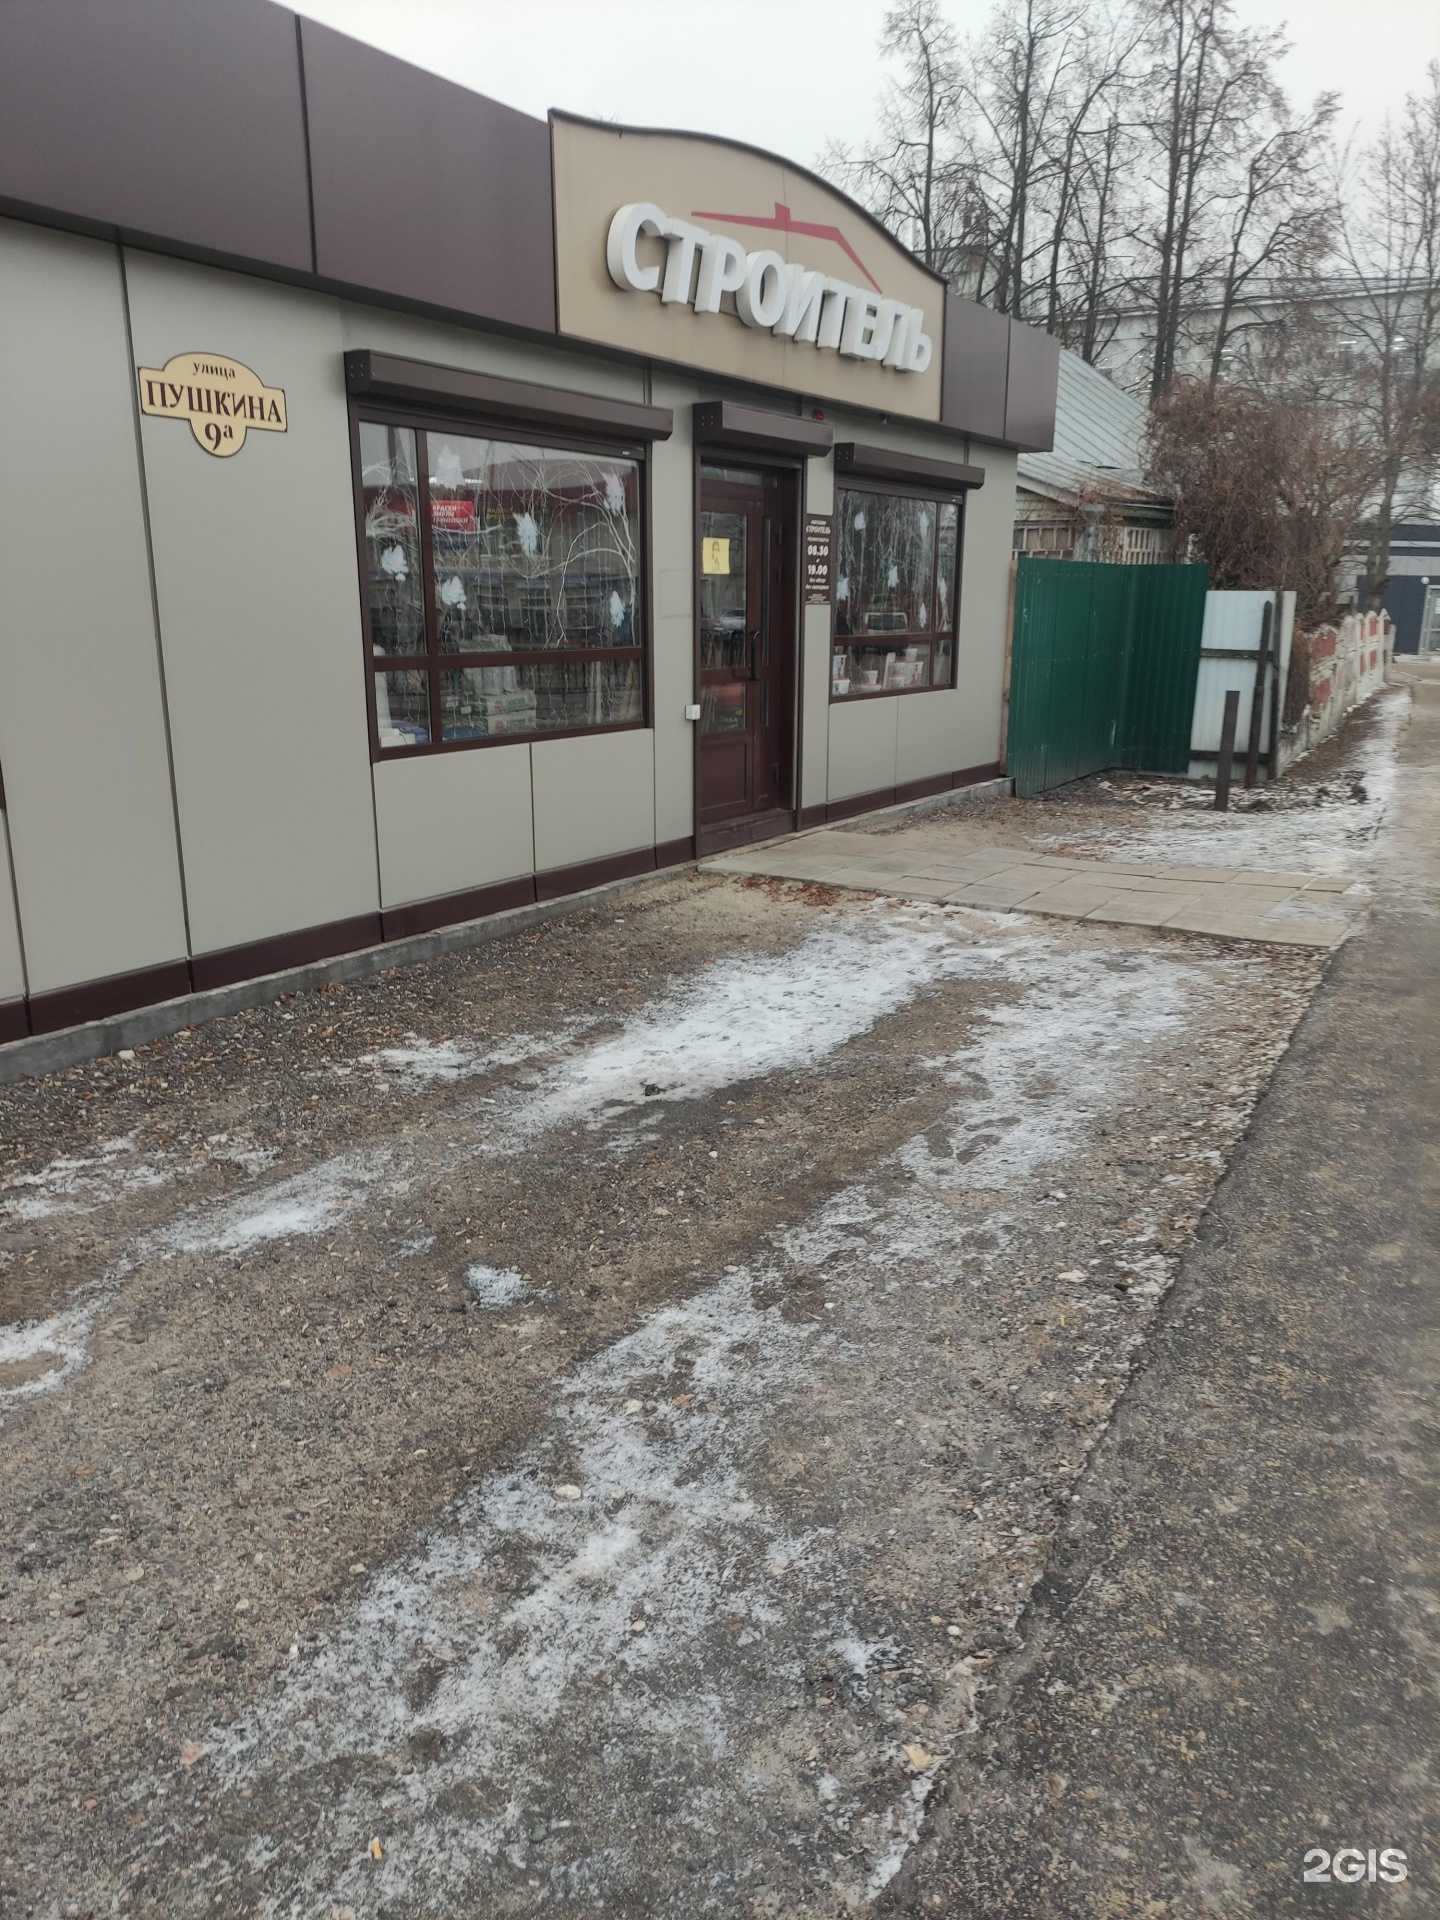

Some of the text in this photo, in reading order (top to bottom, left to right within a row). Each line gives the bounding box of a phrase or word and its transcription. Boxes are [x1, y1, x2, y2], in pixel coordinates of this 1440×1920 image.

[606, 202, 932, 373] СТРОИТЕЛЬ
[192, 361, 236, 380] улица
[146, 380, 283, 424] ПУШКИНА
[205, 423, 234, 451] 9а
